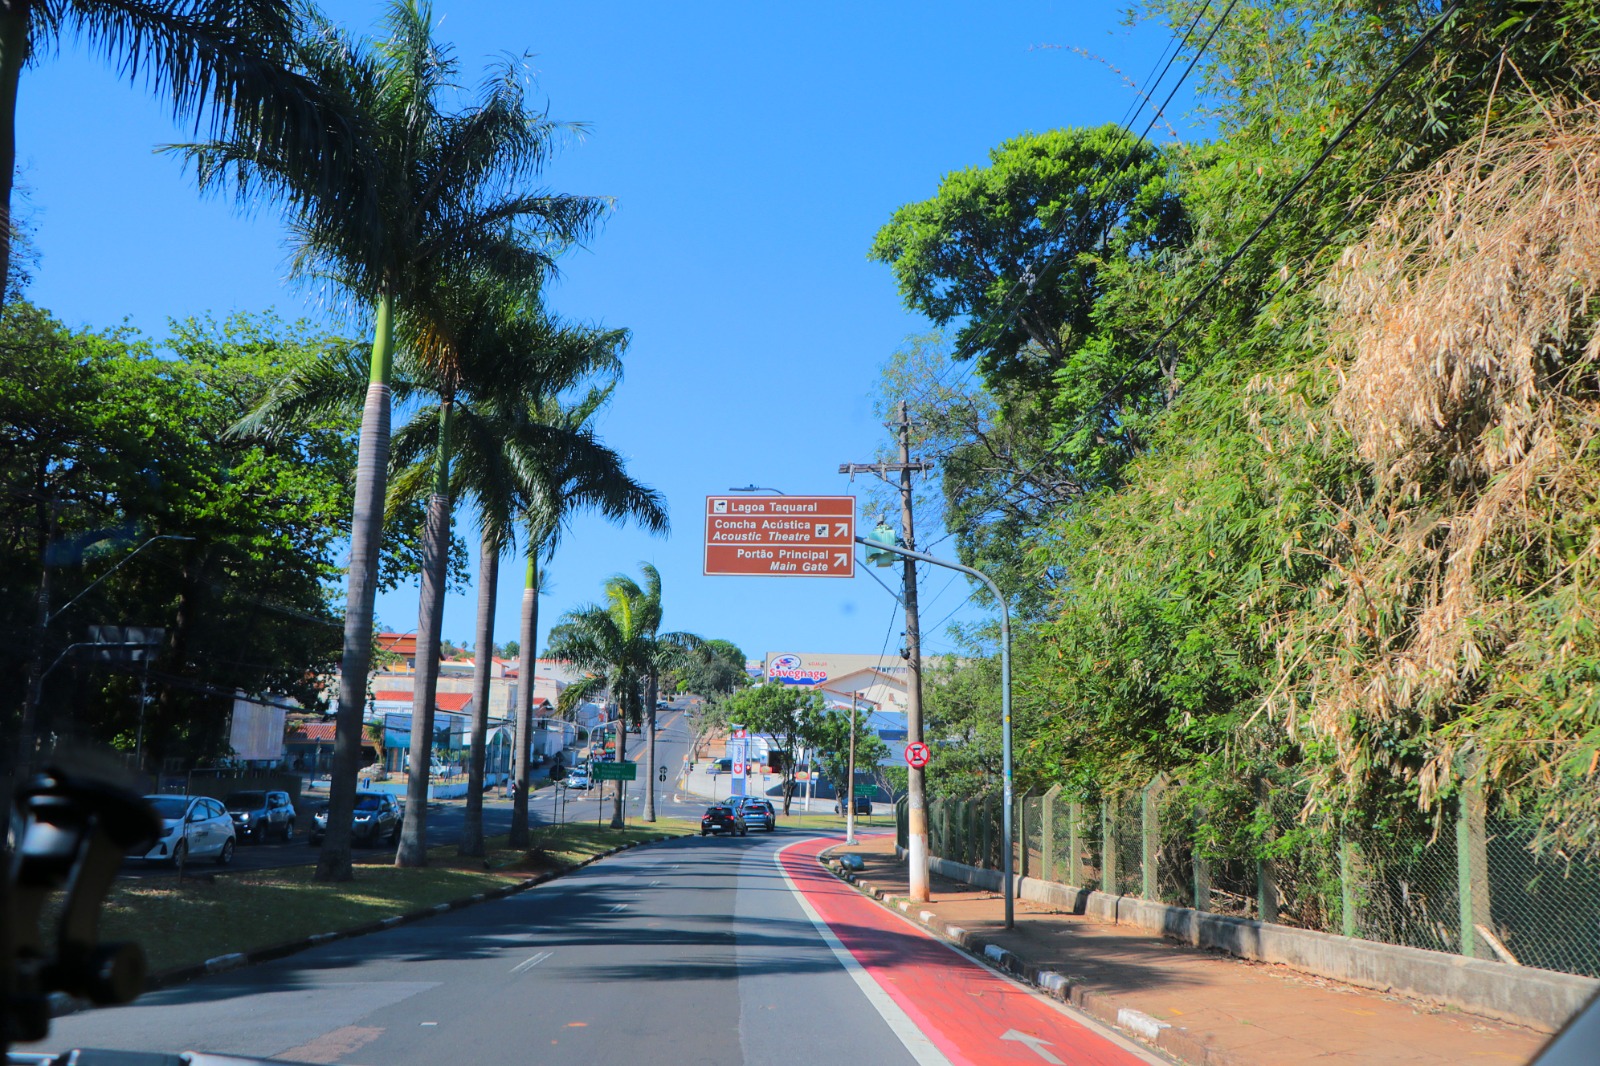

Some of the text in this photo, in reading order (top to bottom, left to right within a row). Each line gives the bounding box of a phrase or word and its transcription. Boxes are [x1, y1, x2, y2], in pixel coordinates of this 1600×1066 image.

[731, 502, 817, 515] Lagoa Taquaral
[715, 519, 811, 530] Concha Acústica
[713, 531, 811, 542] Acoustic Theatre
[737, 548, 829, 561] Portão Principal
[770, 561, 828, 571] Main Gate
[769, 668, 827, 681] Savegnago
